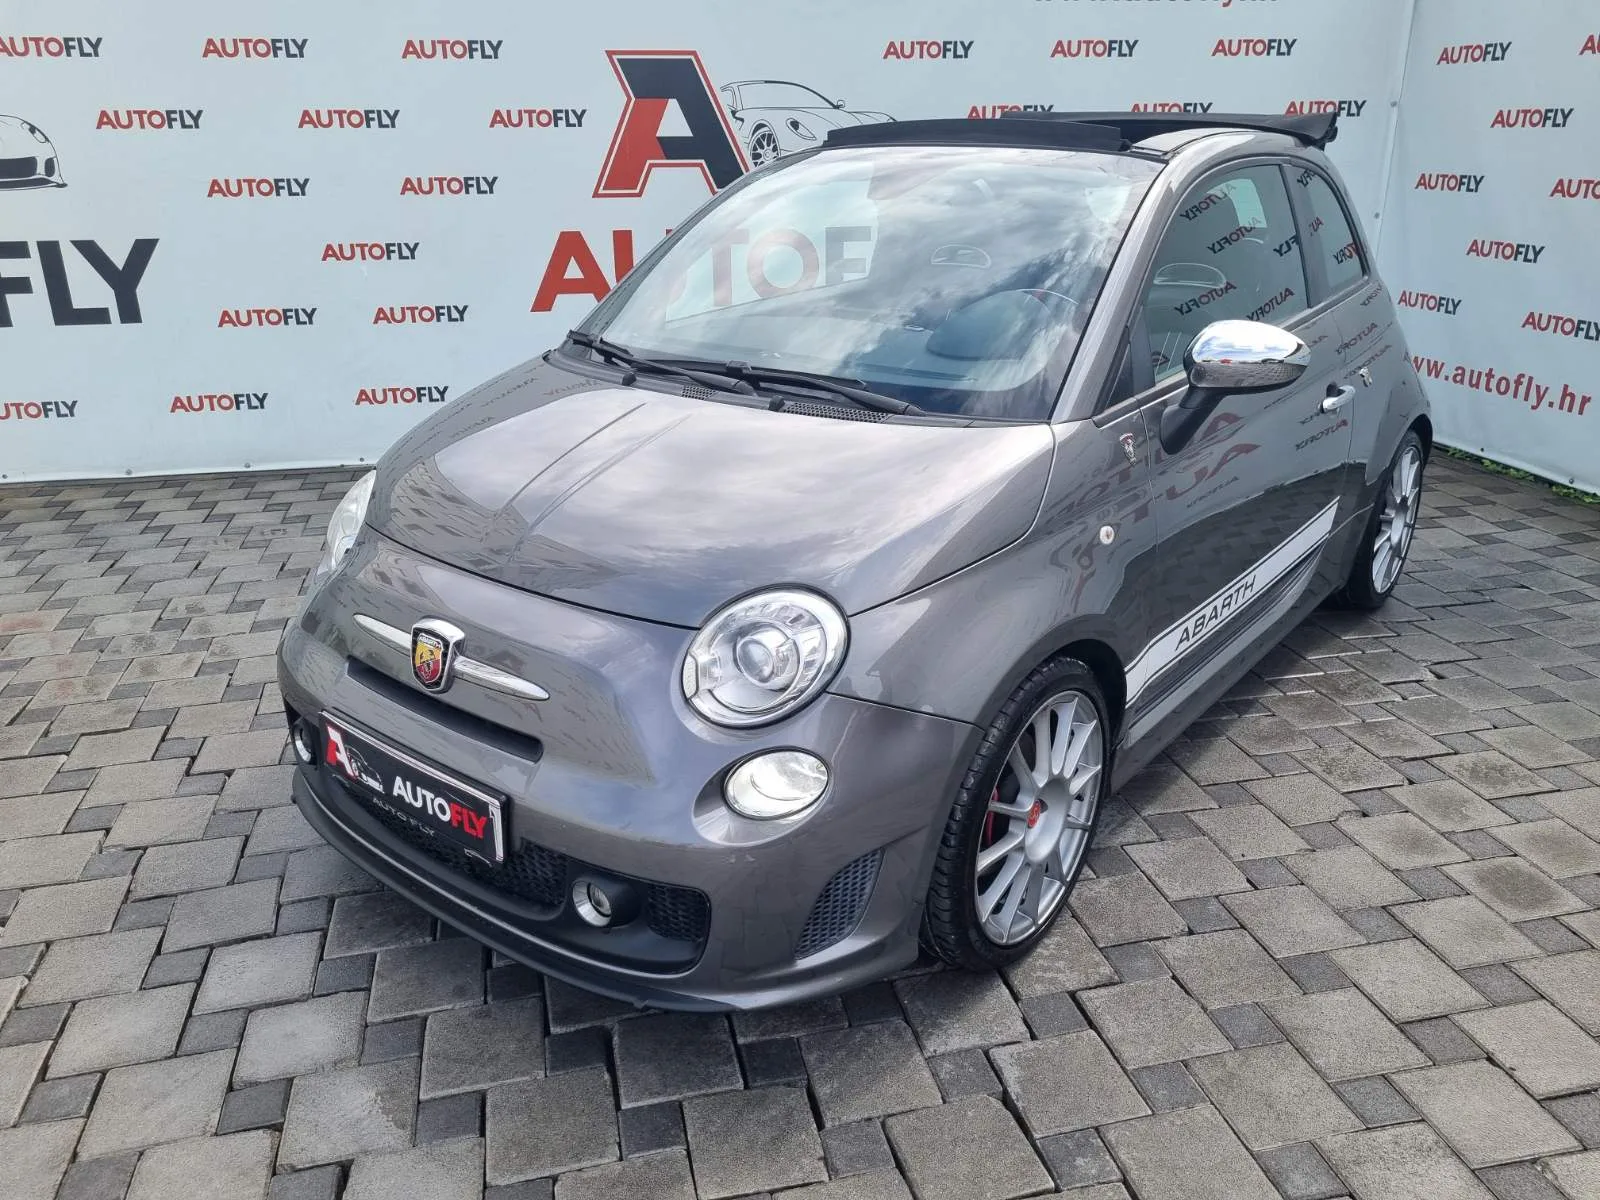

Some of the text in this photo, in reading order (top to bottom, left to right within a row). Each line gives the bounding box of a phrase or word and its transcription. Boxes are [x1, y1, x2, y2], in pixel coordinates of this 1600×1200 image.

[202, 38, 308, 59] AUTOFLY
[402, 39, 503, 59] AUTOFLY
[883, 40, 974, 60] AUTOFLY
[1050, 39, 1139, 58] AUTOFLY
[1212, 38, 1297, 57] AUTOFLY
[1436, 41, 1512, 65] AUTOFLY
[96, 109, 203, 130] AUTOFLY
[298, 109, 400, 129] AUTOFLY
[489, 108, 587, 128] AUTOFLY
[1490, 108, 1574, 128] AUTOFLY
[208, 178, 309, 198] AUTOFLY
[400, 176, 498, 196] AUTOFLY
[1415, 172, 1484, 193] AUTOFLY
[322, 242, 419, 261] AUTOFLY
[1466, 240, 1545, 264] AUTOFLY
[1398, 290, 1461, 316] AUTOFLY
[218, 308, 317, 327] AUTOFLY
[373, 305, 468, 324] AUTOFLY
[170, 393, 268, 414] AUTOFLY
[355, 386, 448, 406] AUTOFLY
[1175, 574, 1256, 652] ABARTH
[392, 775, 488, 839] AUTOFLY
